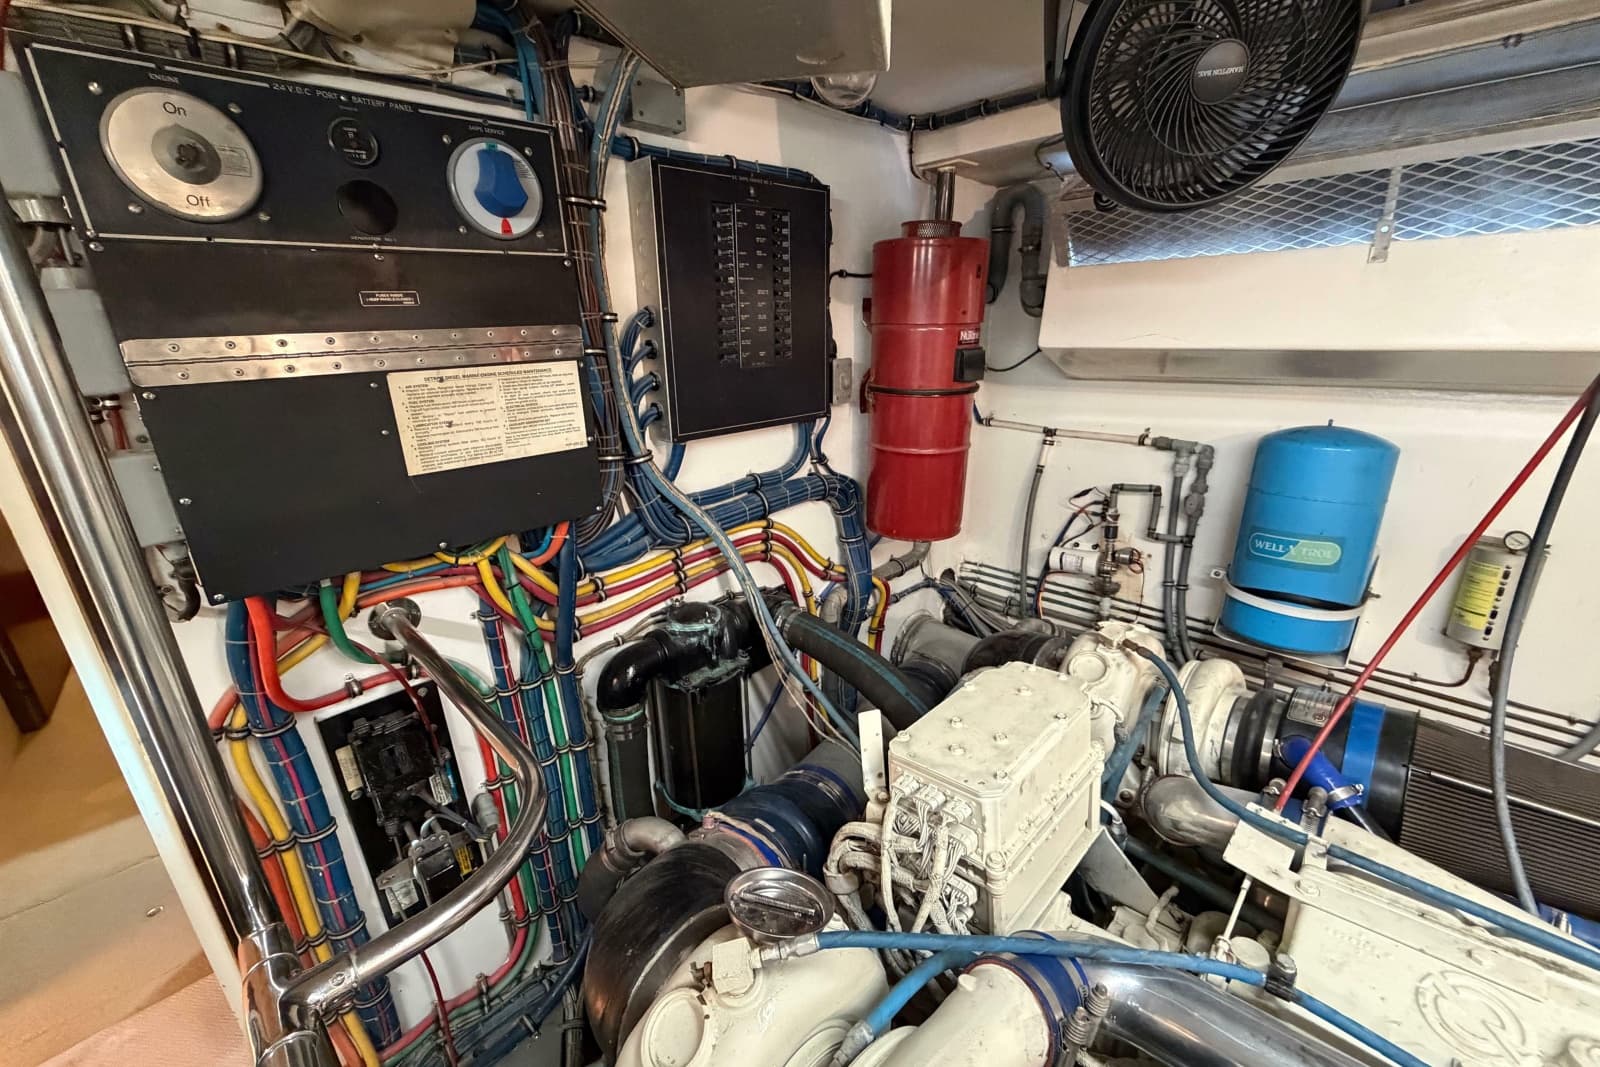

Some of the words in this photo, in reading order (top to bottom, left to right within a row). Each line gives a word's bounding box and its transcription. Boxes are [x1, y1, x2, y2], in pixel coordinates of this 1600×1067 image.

[149, 72, 180, 84] ENGINE
[316, 89, 339, 101] PORT
[351, 95, 386, 108] BATTERY
[389, 102, 414, 113] PANEL
[162, 101, 187, 118] On
[186, 193, 211, 209] Off
